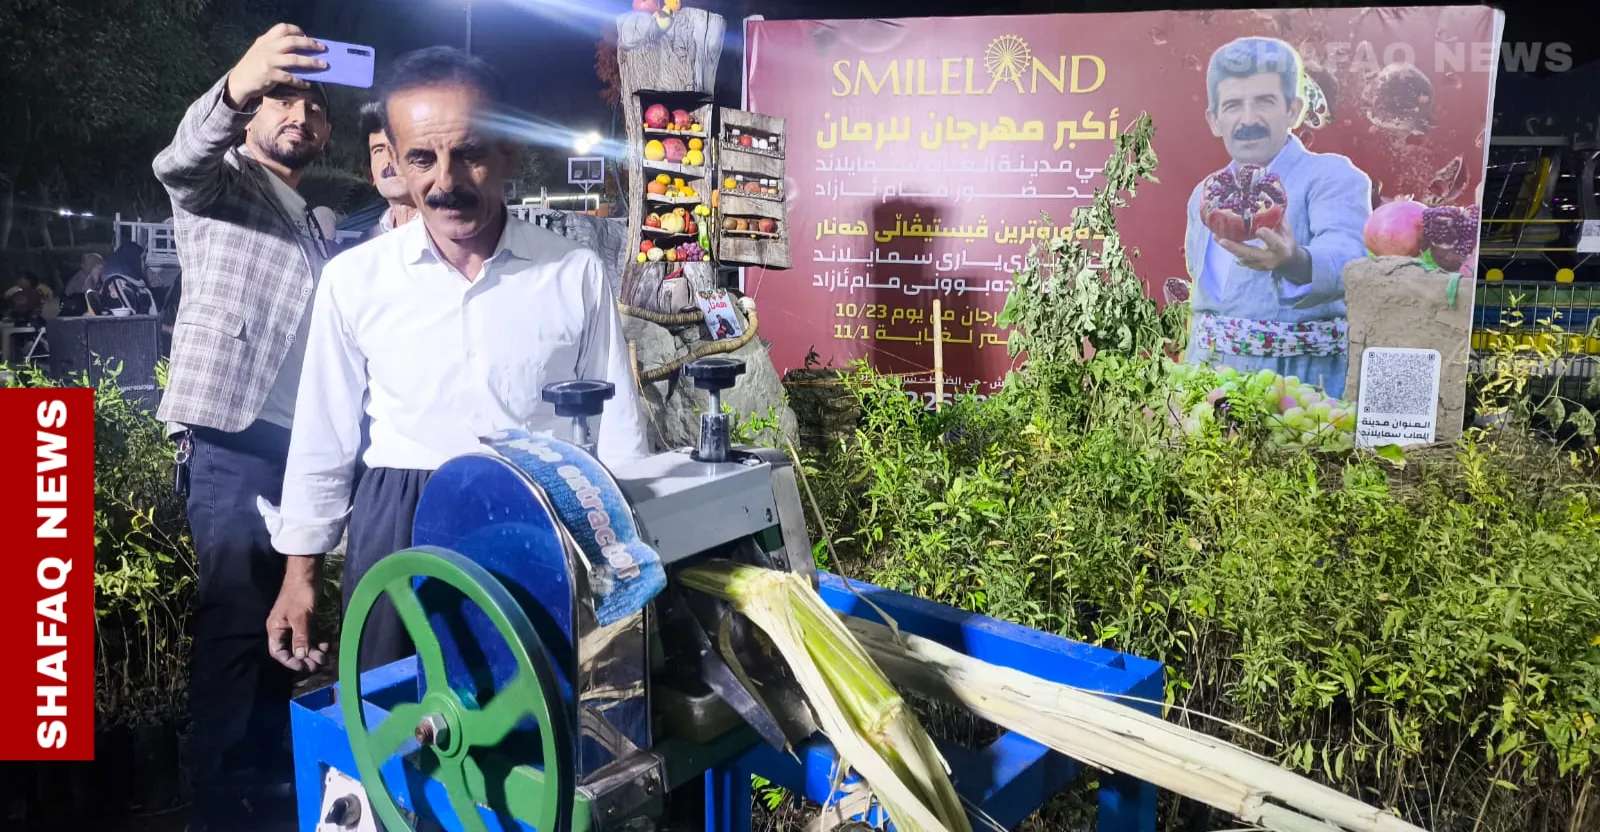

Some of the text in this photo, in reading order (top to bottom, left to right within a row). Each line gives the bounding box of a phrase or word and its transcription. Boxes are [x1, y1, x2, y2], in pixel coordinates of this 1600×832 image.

[832, 48, 1106, 97] SMILELAND
[816, 107, 1120, 151] أكبر مهرجان للرمان
[815, 154, 919, 176] سمايلاند
[998, 154, 1072, 177] مدينة
[815, 176, 878, 202] ئازاد
[882, 180, 949, 204] مام
[835, 303, 888, 319] 10/23
[891, 307, 924, 325] يوم
[834, 324, 870, 340] 11/1
[1361, 417, 1431, 429] العنوان مدينة
[556, 464, 641, 580] extractor
